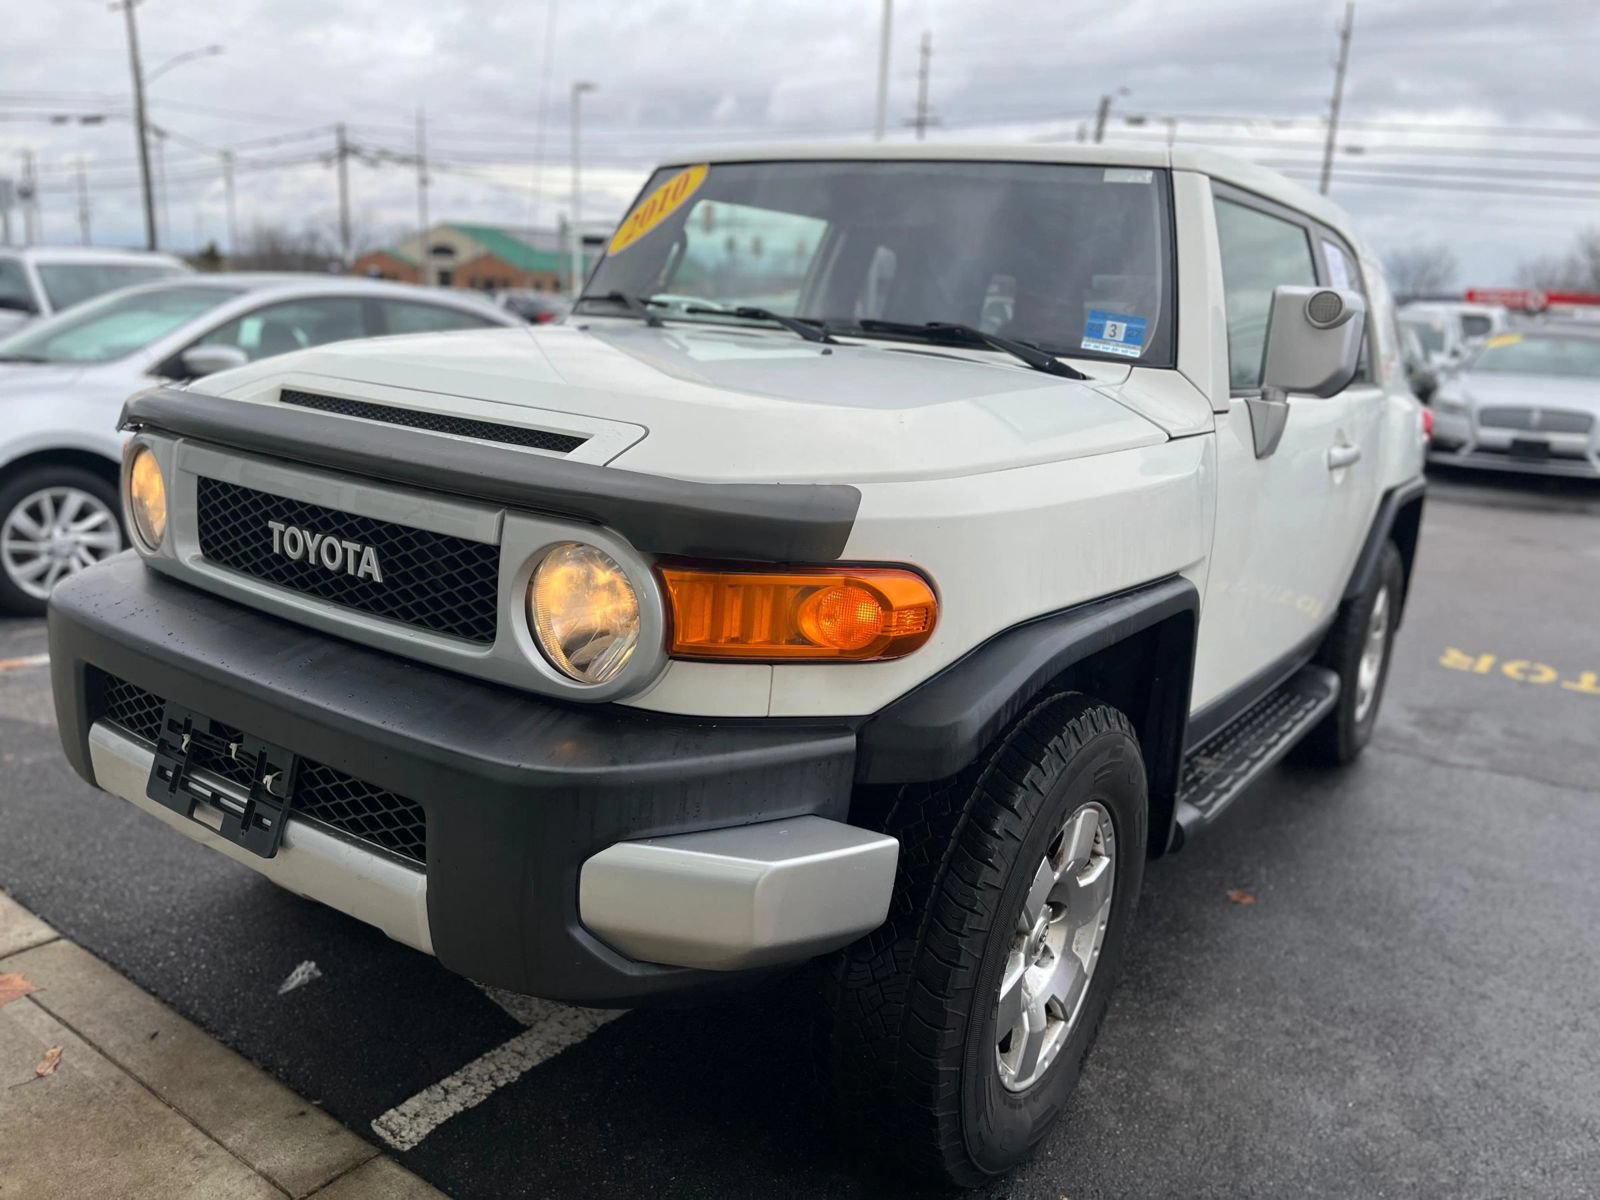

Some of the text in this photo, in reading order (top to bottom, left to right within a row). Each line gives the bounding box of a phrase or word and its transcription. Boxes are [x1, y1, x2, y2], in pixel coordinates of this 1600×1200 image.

[623, 171, 691, 243] 2010
[1108, 323, 1118, 339] 3
[268, 520, 384, 583] TOYOTA
